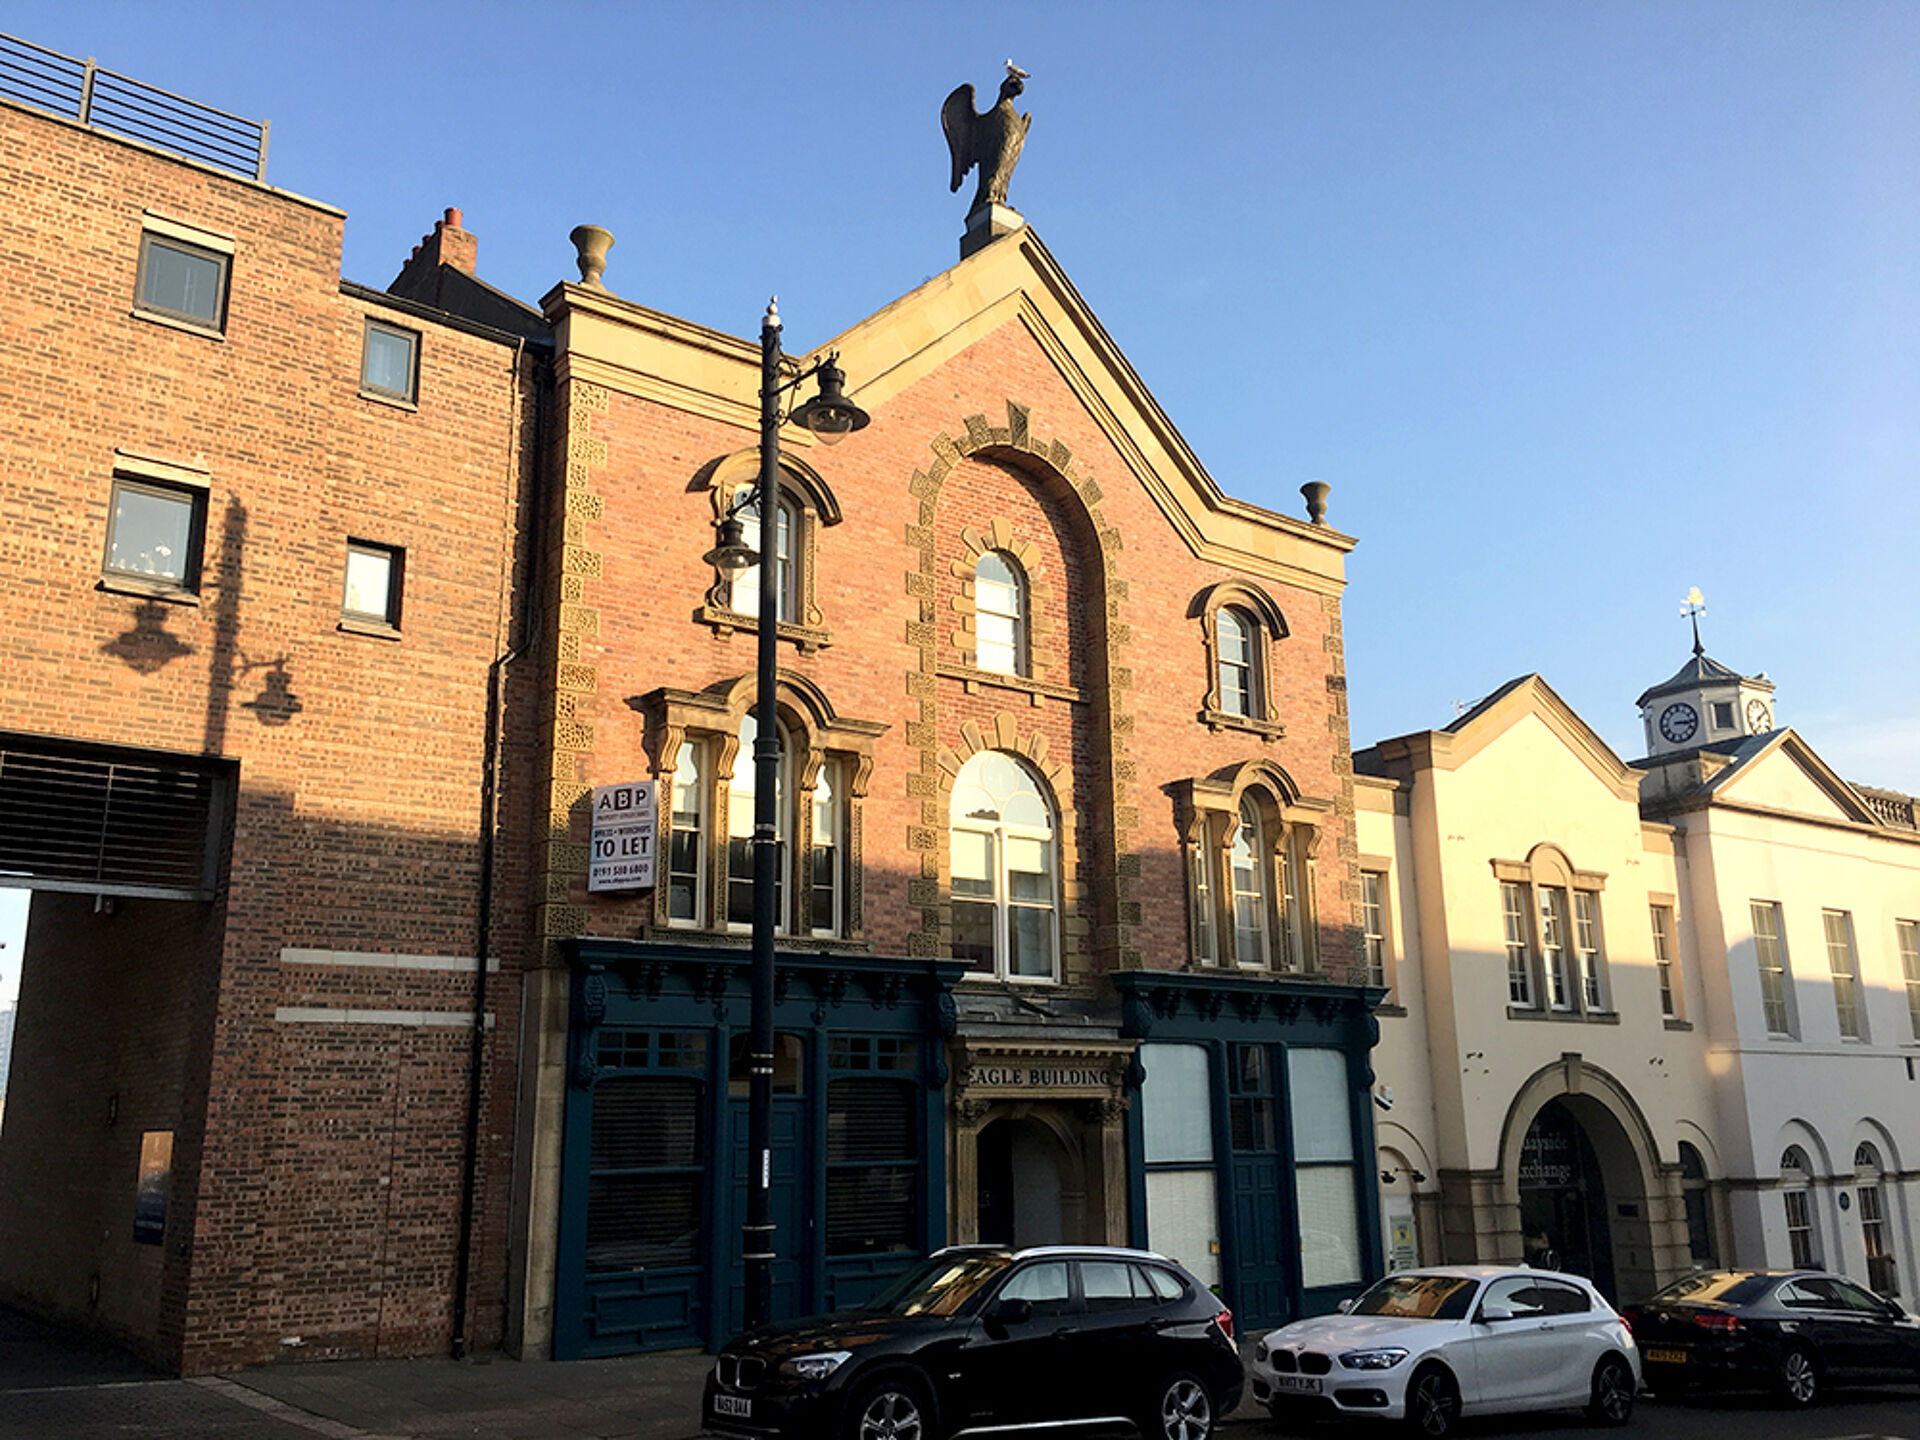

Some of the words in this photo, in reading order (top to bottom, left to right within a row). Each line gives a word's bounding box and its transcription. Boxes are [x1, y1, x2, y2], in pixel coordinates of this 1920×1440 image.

[599, 788, 647, 810] ABP
[595, 839, 616, 858] TO
[622, 836, 649, 856] LET
[1029, 1068, 1111, 1085] BUILDING
[1519, 1160, 1571, 1184] xchange
